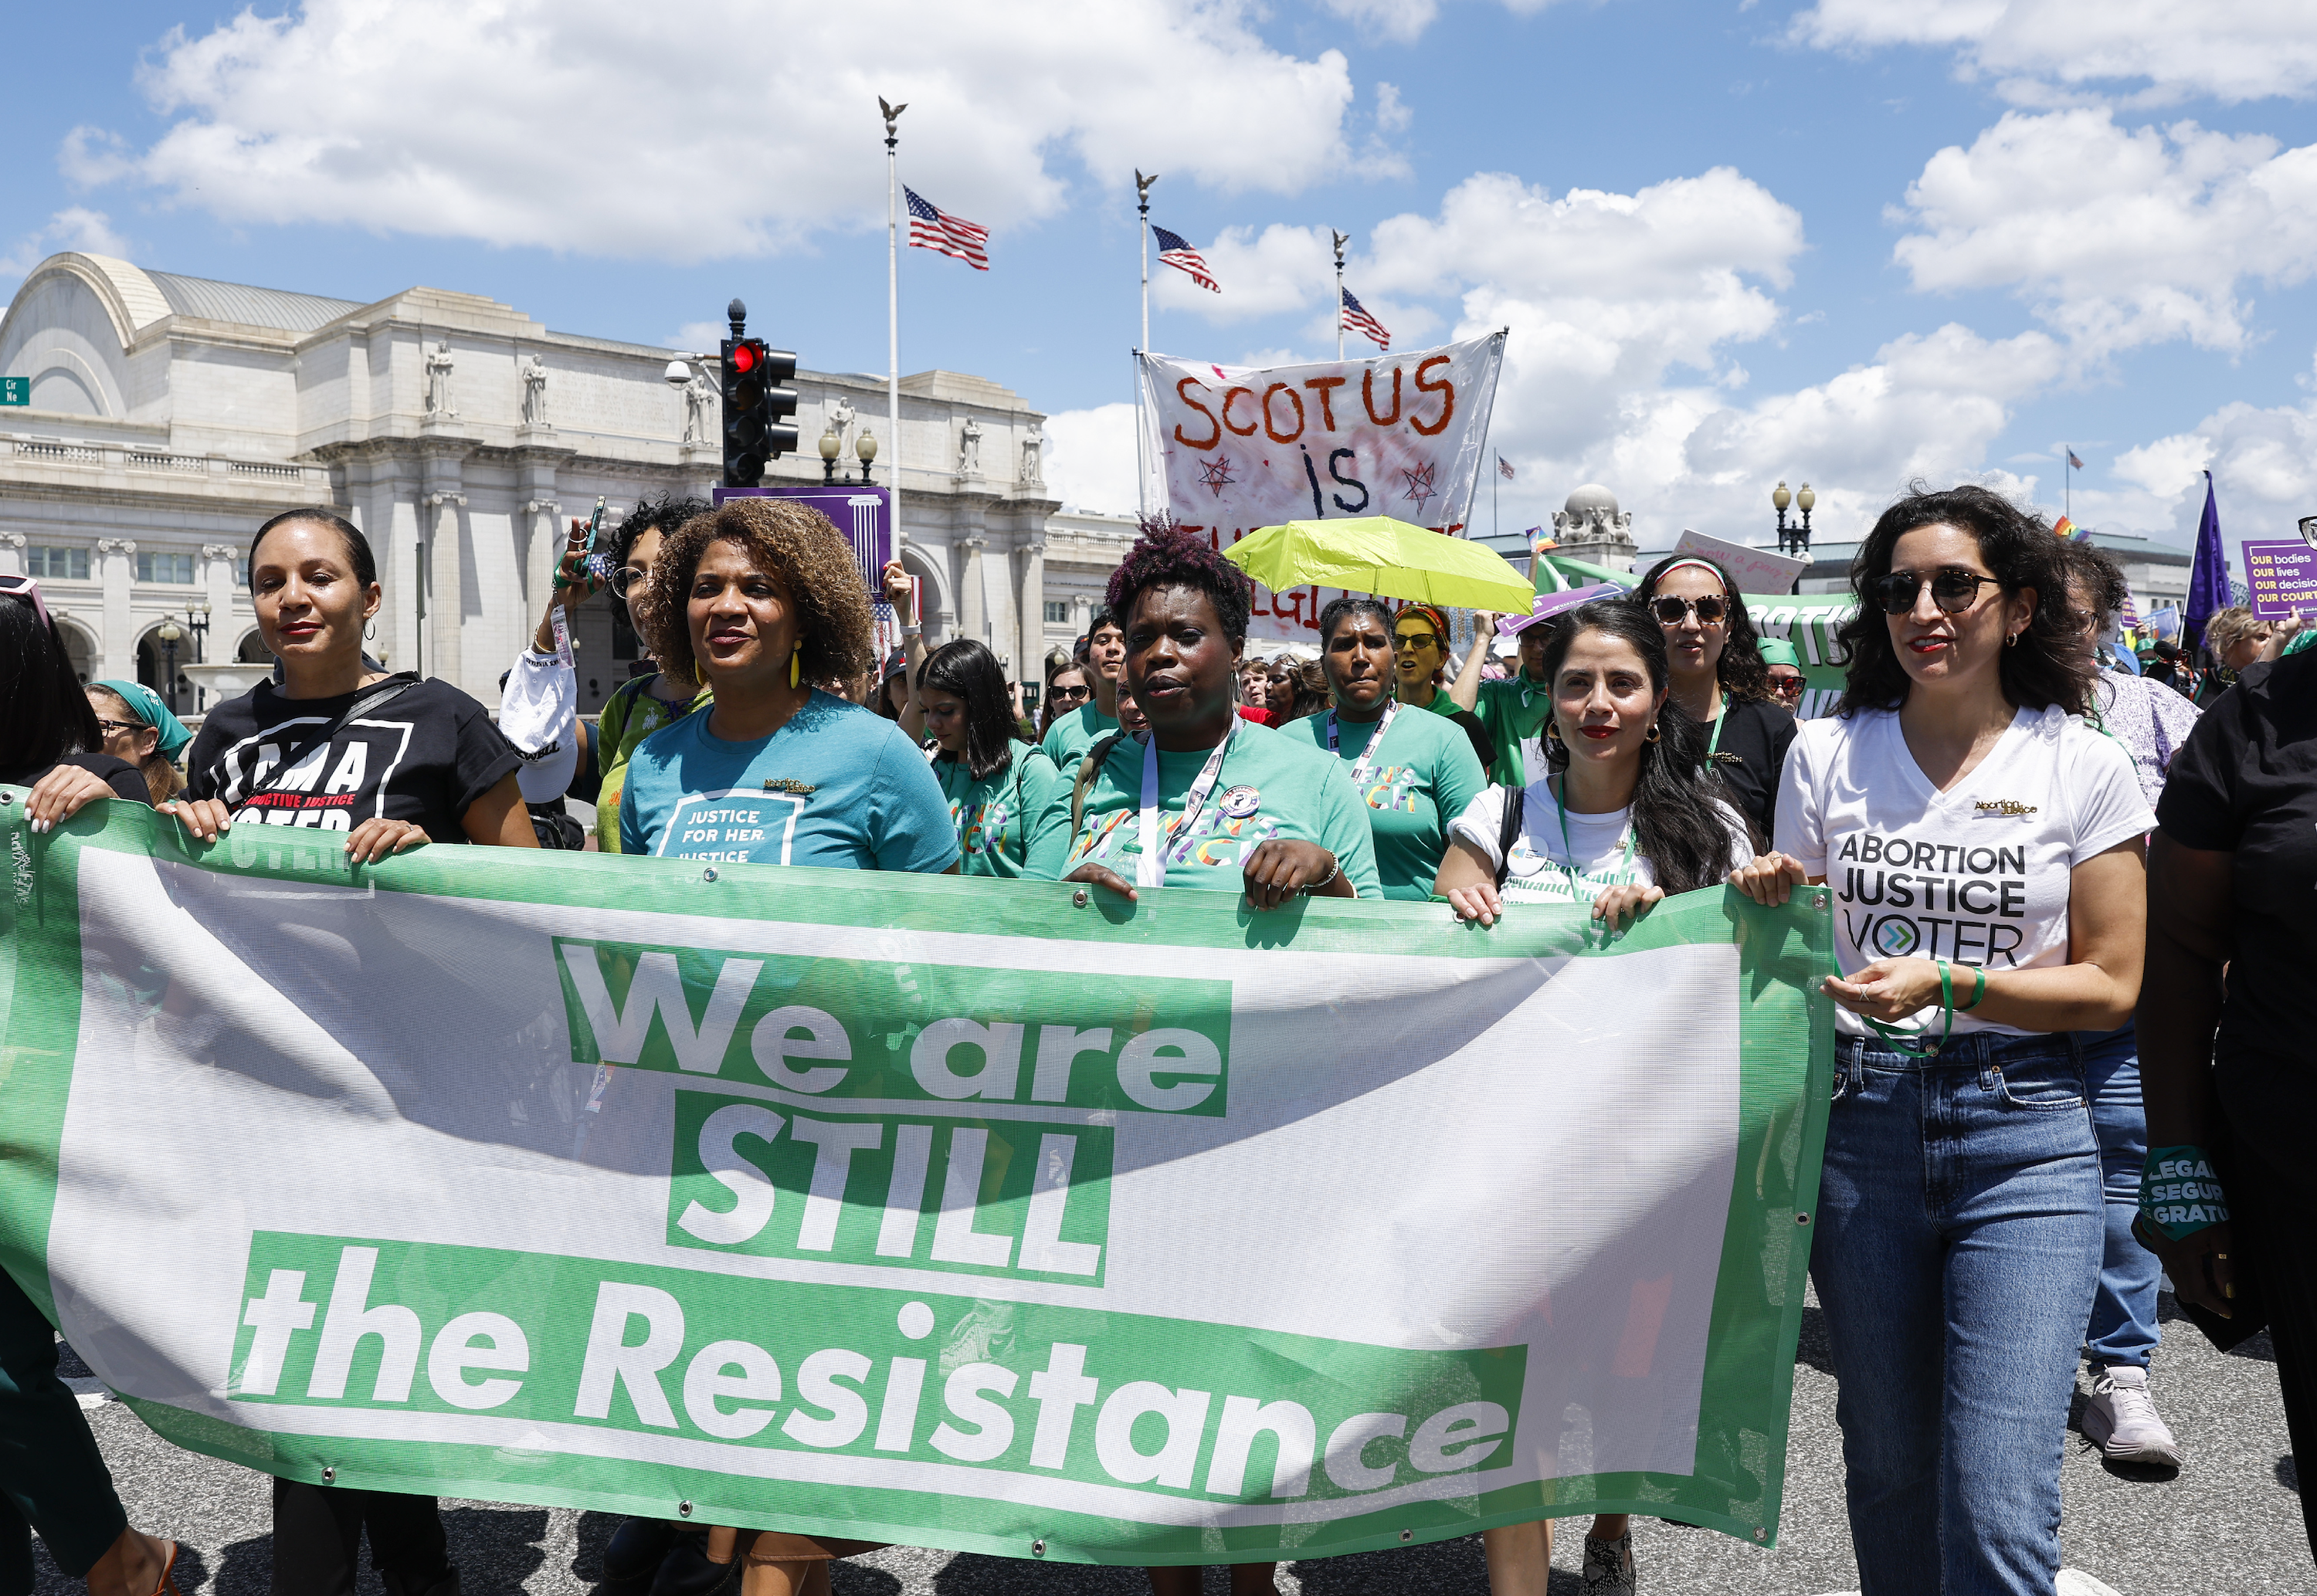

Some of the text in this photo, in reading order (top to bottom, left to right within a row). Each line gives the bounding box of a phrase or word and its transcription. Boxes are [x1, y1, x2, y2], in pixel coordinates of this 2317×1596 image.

[5, 379, 17, 390] Cir
[1174, 355, 1455, 450] SCOTUS
[2251, 554, 2312, 564] OUR bodies
[2253, 567, 2300, 578] OUR lives
[2255, 581, 2277, 590] OUR
[2257, 593, 2279, 603] OUR
[324, 741, 368, 795] A
[303, 794, 358, 808] JUSTICE
[1974, 799, 2020, 811] Abortion
[687, 809, 761, 825] JUSTICE
[2001, 804, 2037, 815] Justice
[682, 829, 765, 843] FOR HER.
[1838, 833, 2025, 875] ABORTION
[1838, 868, 2025, 917] JUSTICE
[1843, 909, 2023, 967] VOTER
[560, 943, 1222, 1111] We are
[676, 1103, 1102, 1276] STILL
[239, 1245, 1511, 1499] the Resistance
